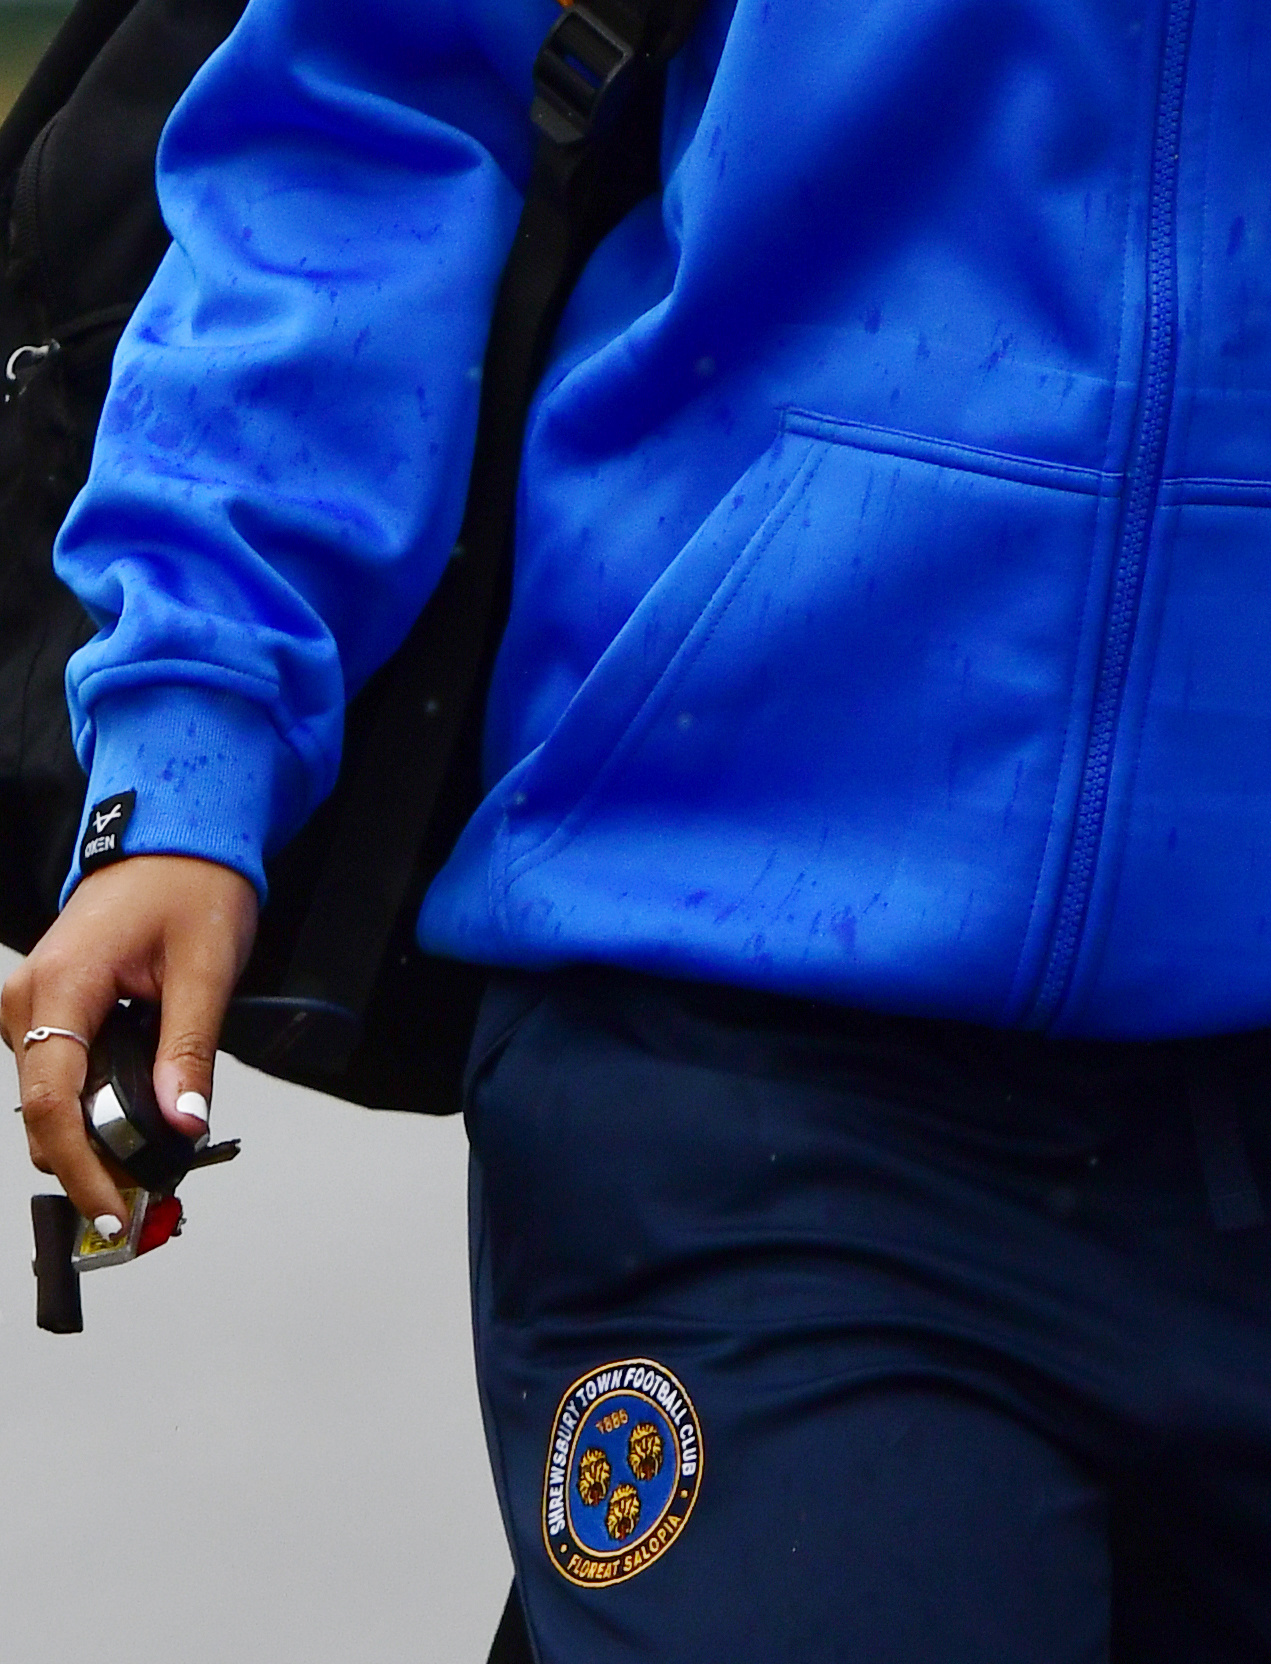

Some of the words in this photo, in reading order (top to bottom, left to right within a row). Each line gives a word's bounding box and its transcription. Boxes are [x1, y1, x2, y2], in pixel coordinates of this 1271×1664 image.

[84, 834, 115, 859] OXEN
[595, 1408, 628, 1434] 1886
[548, 1399, 581, 1536] SHREWSBURY
[575, 1369, 623, 1407] TOWN
[624, 1367, 688, 1426] FOOTBALL
[679, 1423, 698, 1477] CLUB
[566, 1554, 621, 1579] FLOREAT
[623, 1514, 682, 1573] SALOPIA
